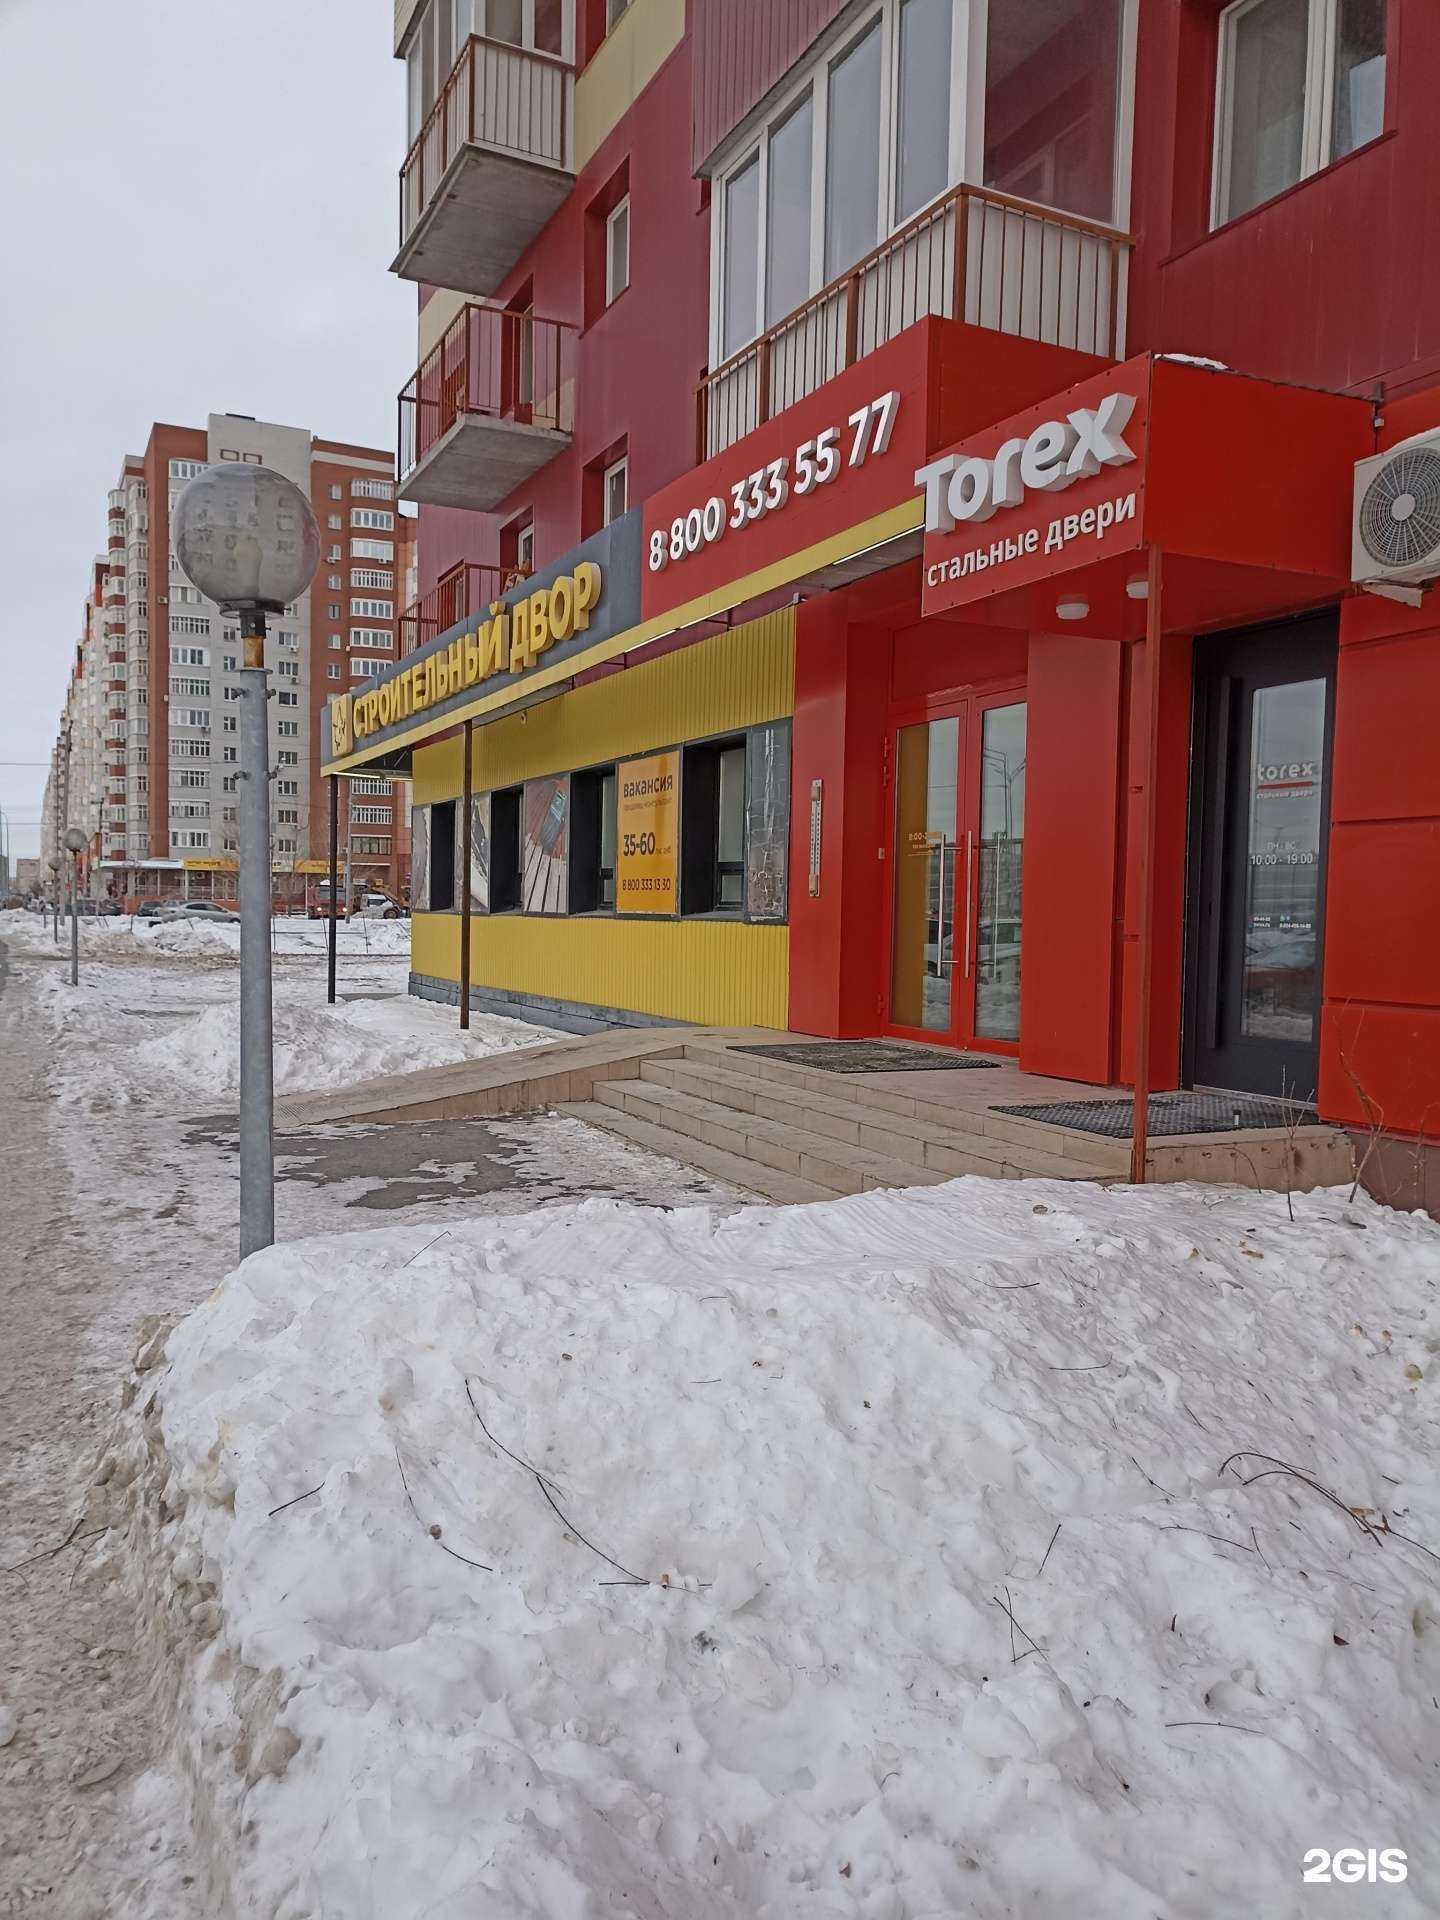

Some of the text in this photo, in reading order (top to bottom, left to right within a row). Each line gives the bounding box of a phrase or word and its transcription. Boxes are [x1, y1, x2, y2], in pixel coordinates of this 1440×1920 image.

[649, 391, 900, 572] 8 800 333 55 77
[927, 492, 1136, 588] стальные двери
[353, 561, 602, 738] СТРОИТЕЛЬНЫЙ ДВОР
[623, 775, 673, 798] вакансия
[623, 832, 656, 857] 35-60
[641, 878, 653, 891] 333
